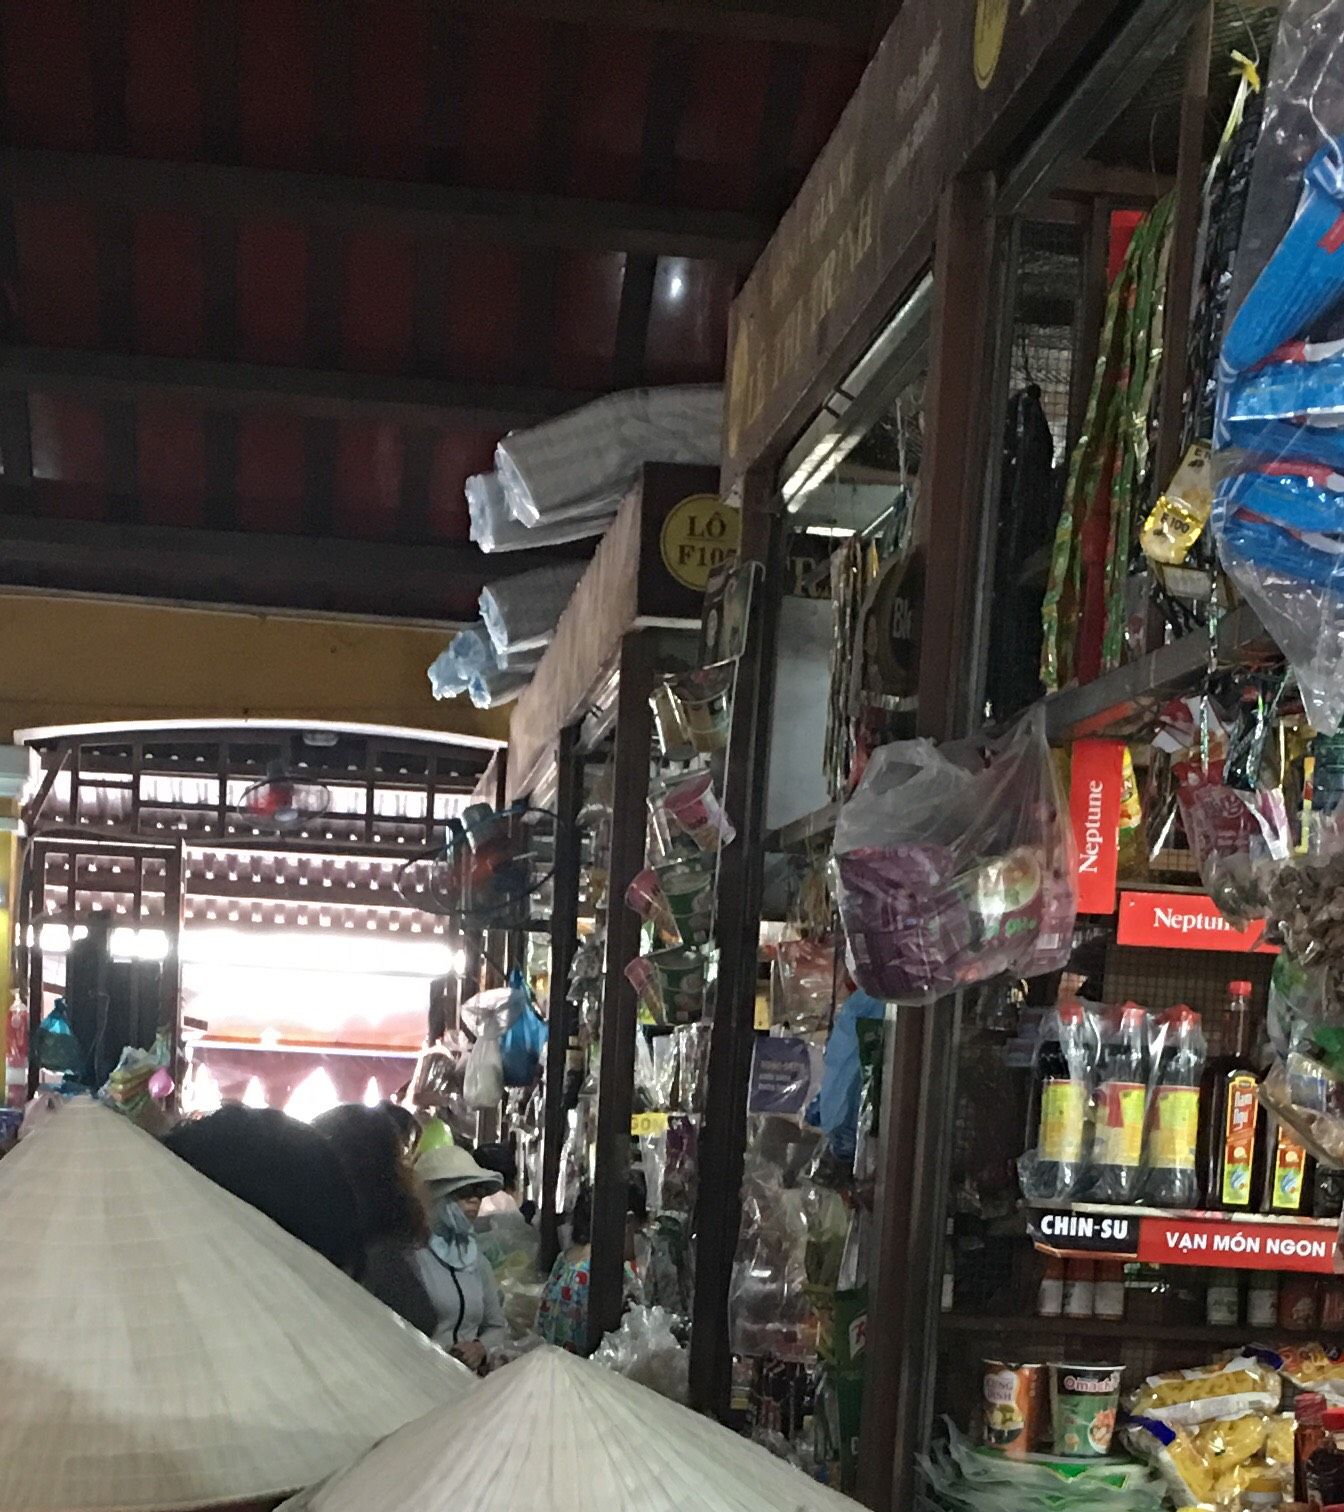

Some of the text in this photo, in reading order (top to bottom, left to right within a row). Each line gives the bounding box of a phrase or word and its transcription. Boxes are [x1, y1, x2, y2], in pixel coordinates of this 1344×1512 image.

[687, 512, 727, 538] LÔ
[1079, 780, 1104, 874] Neptune
[1153, 907, 1234, 933] Neptun
[1040, 1214, 1129, 1240] CHIN-SU
[1165, 1231, 1326, 1258] VẠN MÓN NGON
